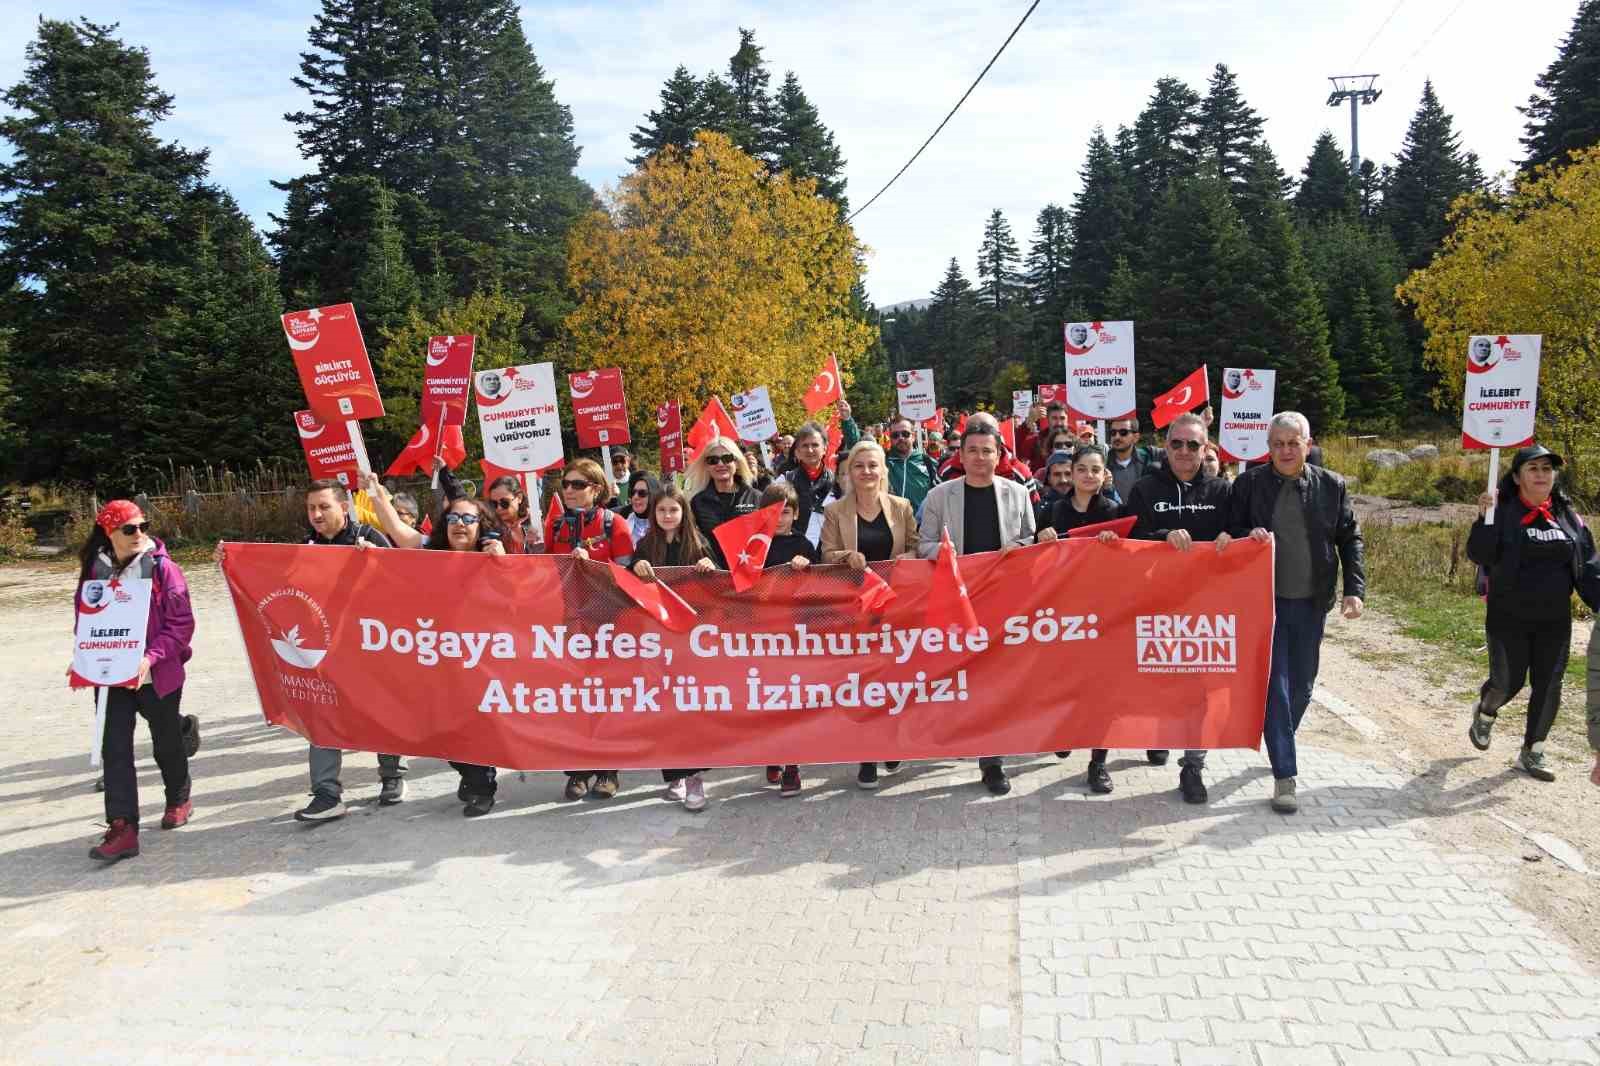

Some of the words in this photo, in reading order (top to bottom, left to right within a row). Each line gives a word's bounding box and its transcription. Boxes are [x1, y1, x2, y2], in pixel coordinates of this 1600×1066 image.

[315, 360, 352, 373] BİRLİKTE
[1072, 365, 1128, 376] ATATÜRK'ÜN
[315, 369, 361, 386] GÜÇLÜYÜZ
[1079, 376, 1123, 387] İZİNDEYİZ
[1480, 386, 1521, 398] İLELEBET
[1468, 399, 1531, 411] CUMHURİYET
[1233, 411, 1262, 420] YAŞASIN
[505, 418, 537, 430] İZİNDE
[1224, 420, 1269, 431] CUMHURİYET
[494, 428, 551, 443] YÜRÜYORUZ
[1154, 501, 1216, 513] Champion
[1136, 614, 1236, 638] ERKAN
[90, 627, 131, 638] İLELEBET
[79, 639, 140, 650] CUMHURİYET
[359, 617, 516, 668] Doğaya
[531, 623, 674, 666] Nefes,
[689, 623, 990, 664] Cumhuriyete
[1141, 640, 1231, 662] AYDIN
[478, 675, 733, 714] Atatürk'ün
[746, 667, 968, 715] İzindeyiz!
